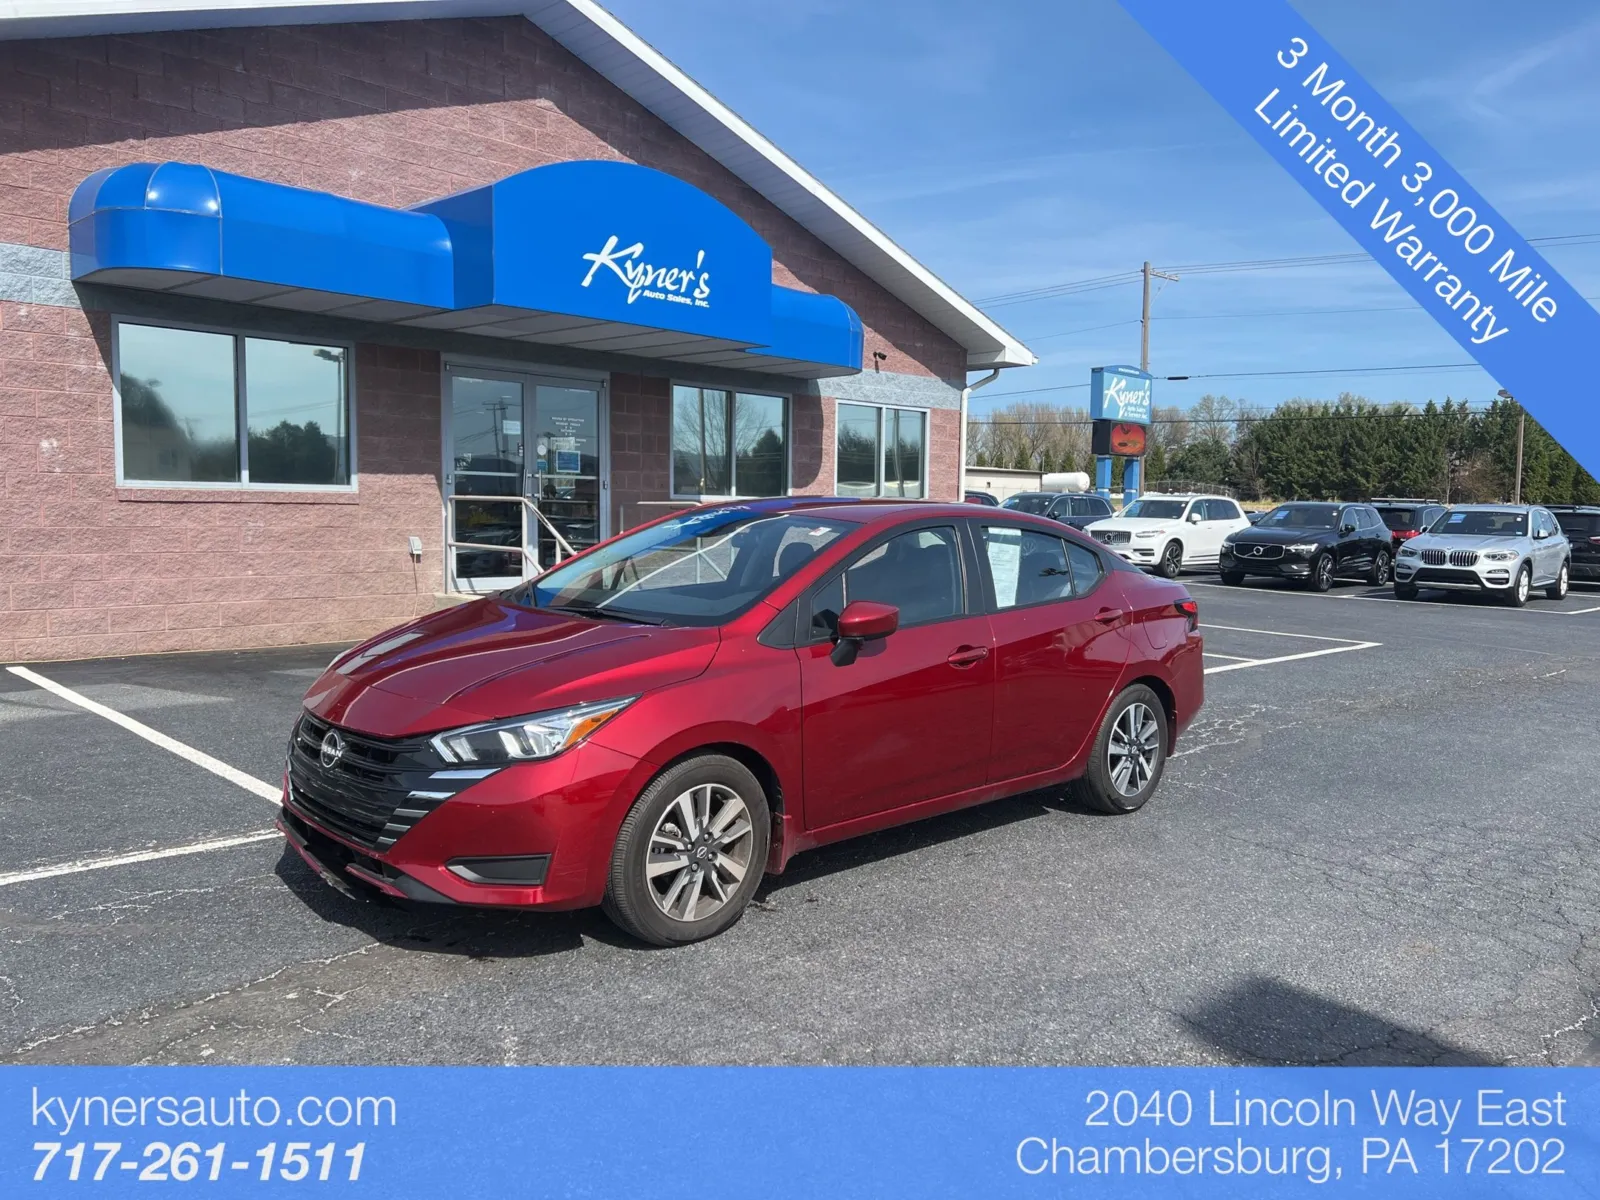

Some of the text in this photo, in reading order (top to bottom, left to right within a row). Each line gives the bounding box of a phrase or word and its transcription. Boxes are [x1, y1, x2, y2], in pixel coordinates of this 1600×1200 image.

[581, 235, 710, 304] Kyner's
[643, 289, 666, 300] Auto
[666, 293, 693, 305] Sales,
[1103, 377, 1150, 418] Kyner's
